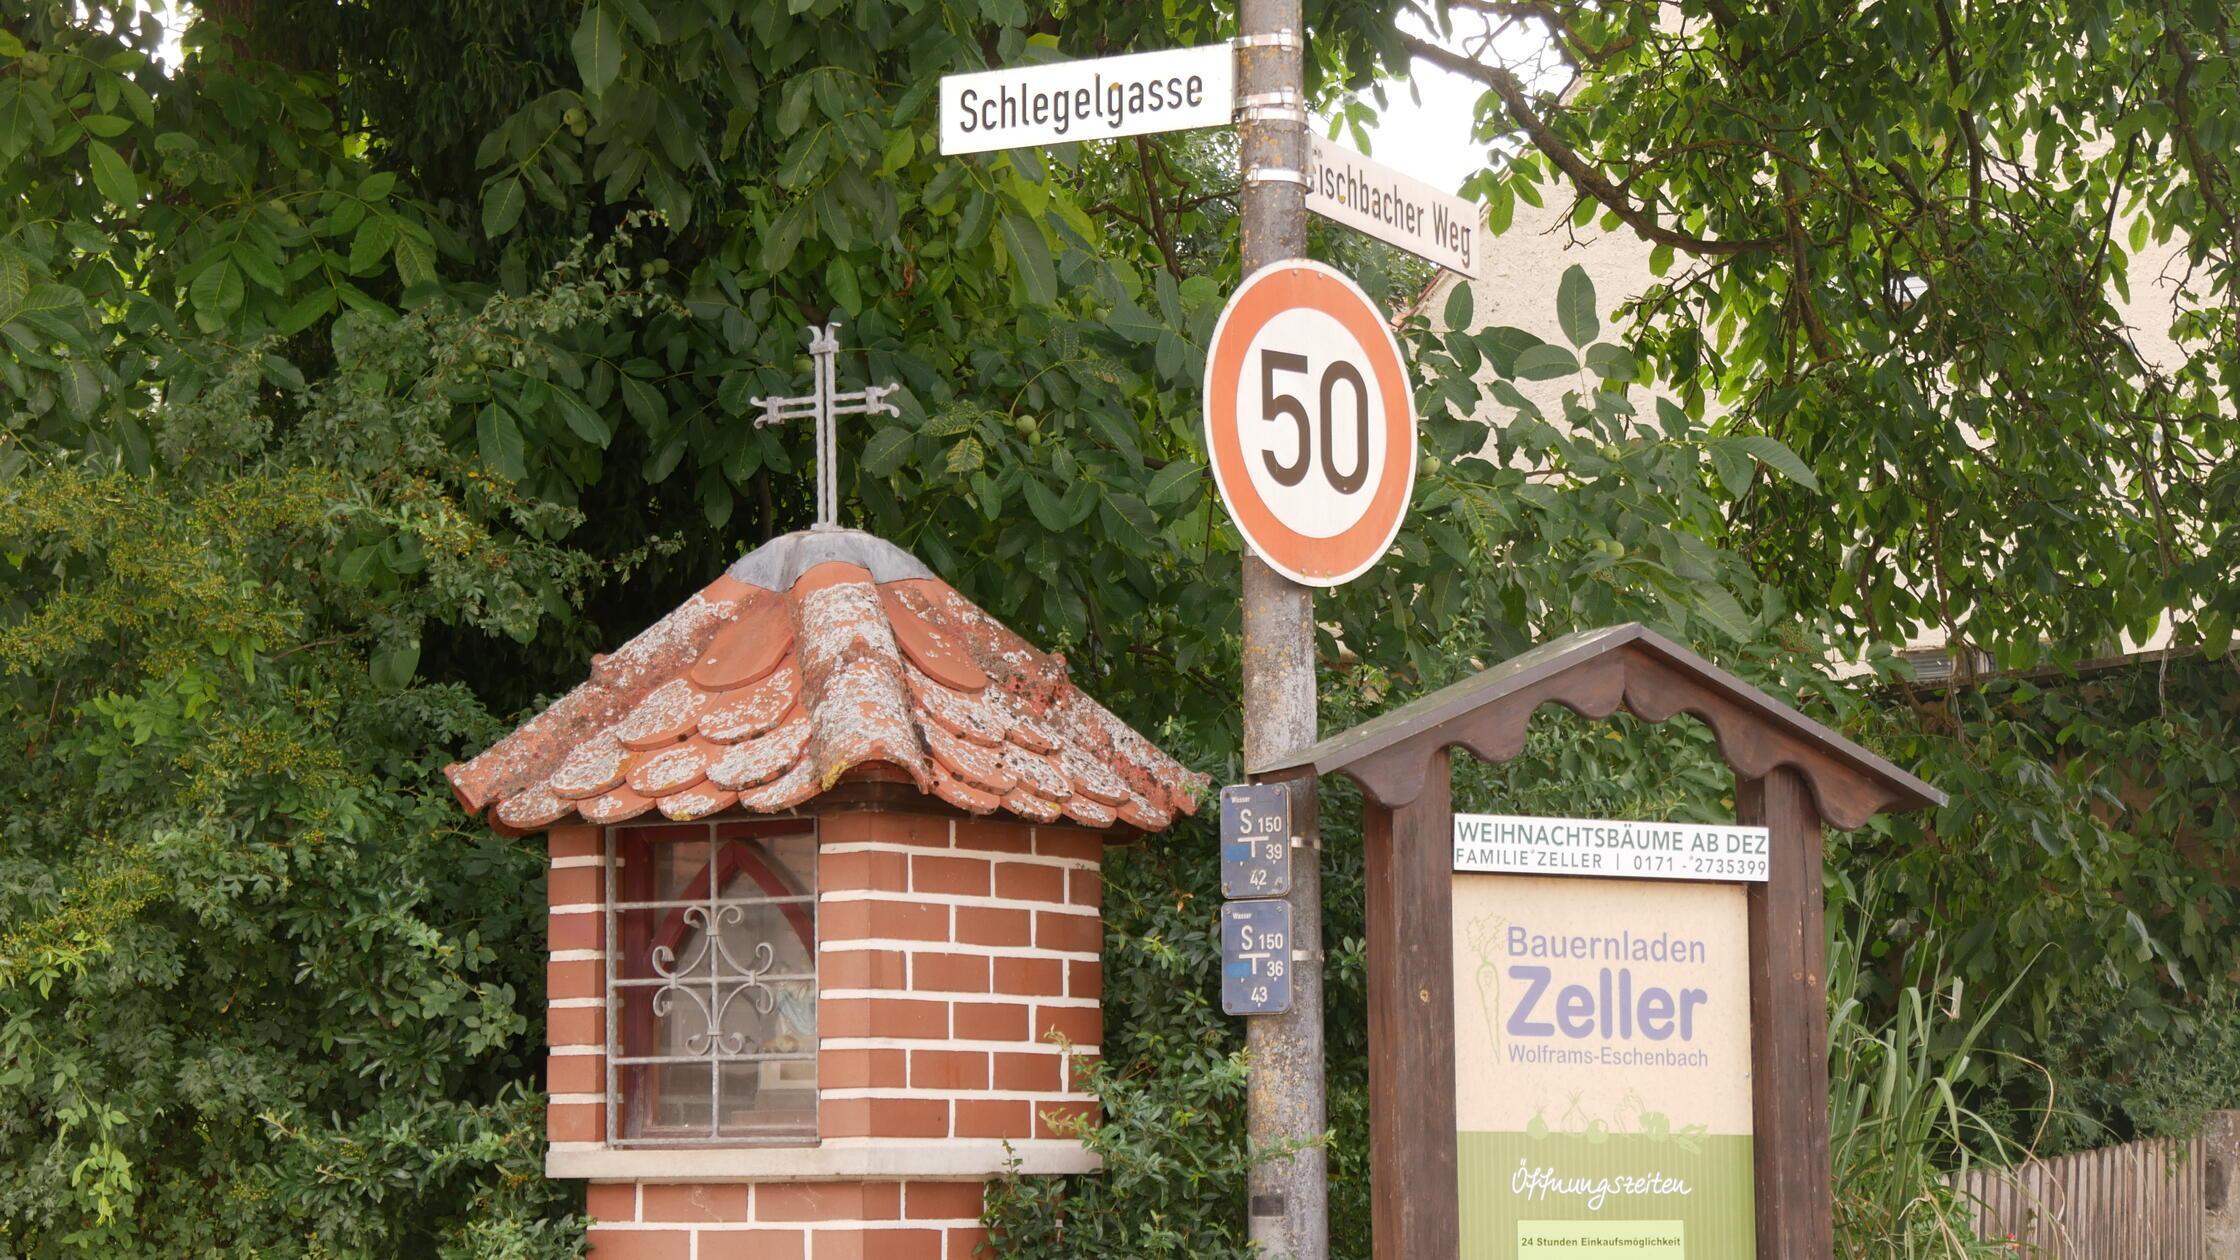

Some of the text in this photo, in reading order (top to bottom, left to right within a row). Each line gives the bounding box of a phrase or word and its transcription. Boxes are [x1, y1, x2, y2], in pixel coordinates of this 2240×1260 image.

[959, 73, 1203, 135] Schlegelgasse
[1312, 149, 1472, 269] ischbacher Weg
[1260, 348, 1370, 496] 50
[1239, 808, 1282, 834] S 150
[1457, 821, 1767, 855] WEIHNACHTSBÄUME AB DEZ
[1455, 848, 1528, 865] FAMILIE
[1537, 851, 1603, 869] ZELLER
[1633, 854, 1674, 872] 0171
[1694, 859, 1767, 876] 2735399
[1241, 925, 1284, 950] S 150
[1507, 926, 1706, 963] Bauernladen
[1506, 965, 1708, 1041] Zeller
[1508, 1044, 1708, 1067] Wolframs-Eschenbach
[1511, 1158, 1692, 1210] Öffnungszeiten
[1521, 1236, 1681, 1248] 24 Stunden Einkaufsmöglichkeit
